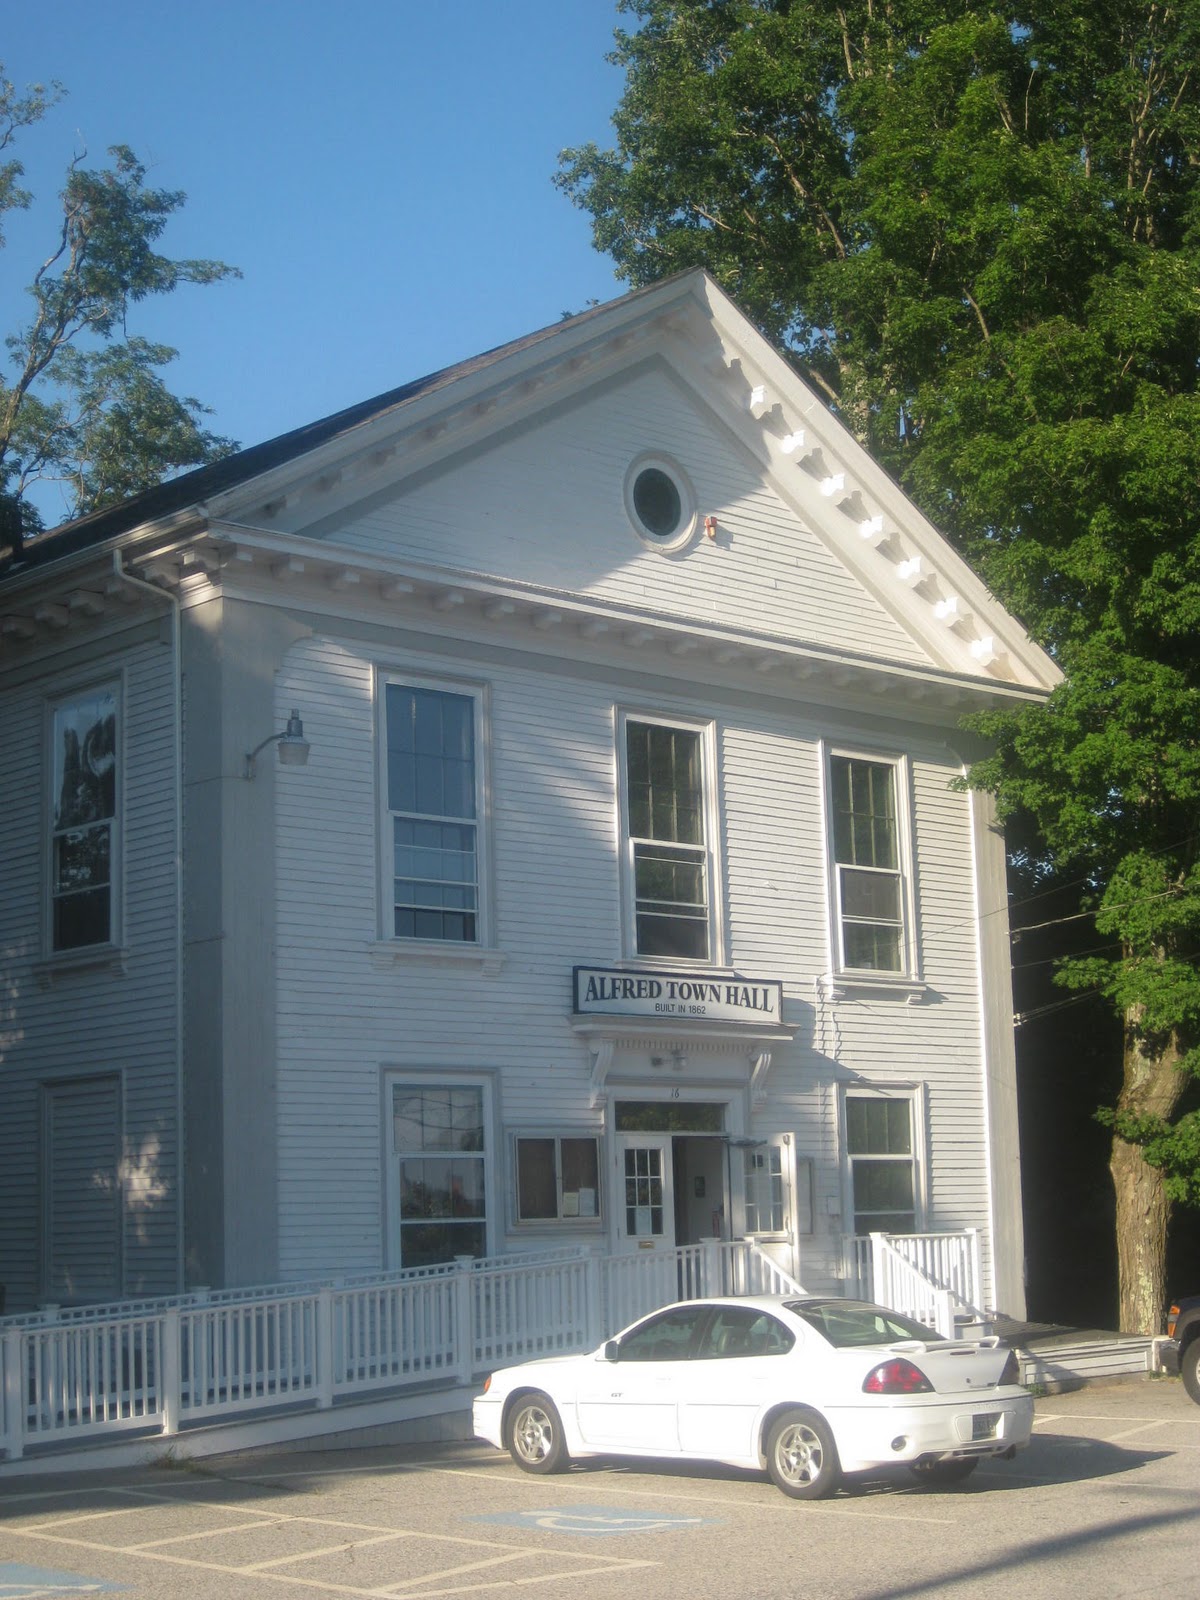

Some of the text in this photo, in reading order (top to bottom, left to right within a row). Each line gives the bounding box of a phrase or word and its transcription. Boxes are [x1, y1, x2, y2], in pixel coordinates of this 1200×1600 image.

[585, 976, 774, 1013] ALFRED TOWN HALL
[655, 1003, 706, 1015] BUILT IN 1862
[671, 1088, 680, 1099] 16
